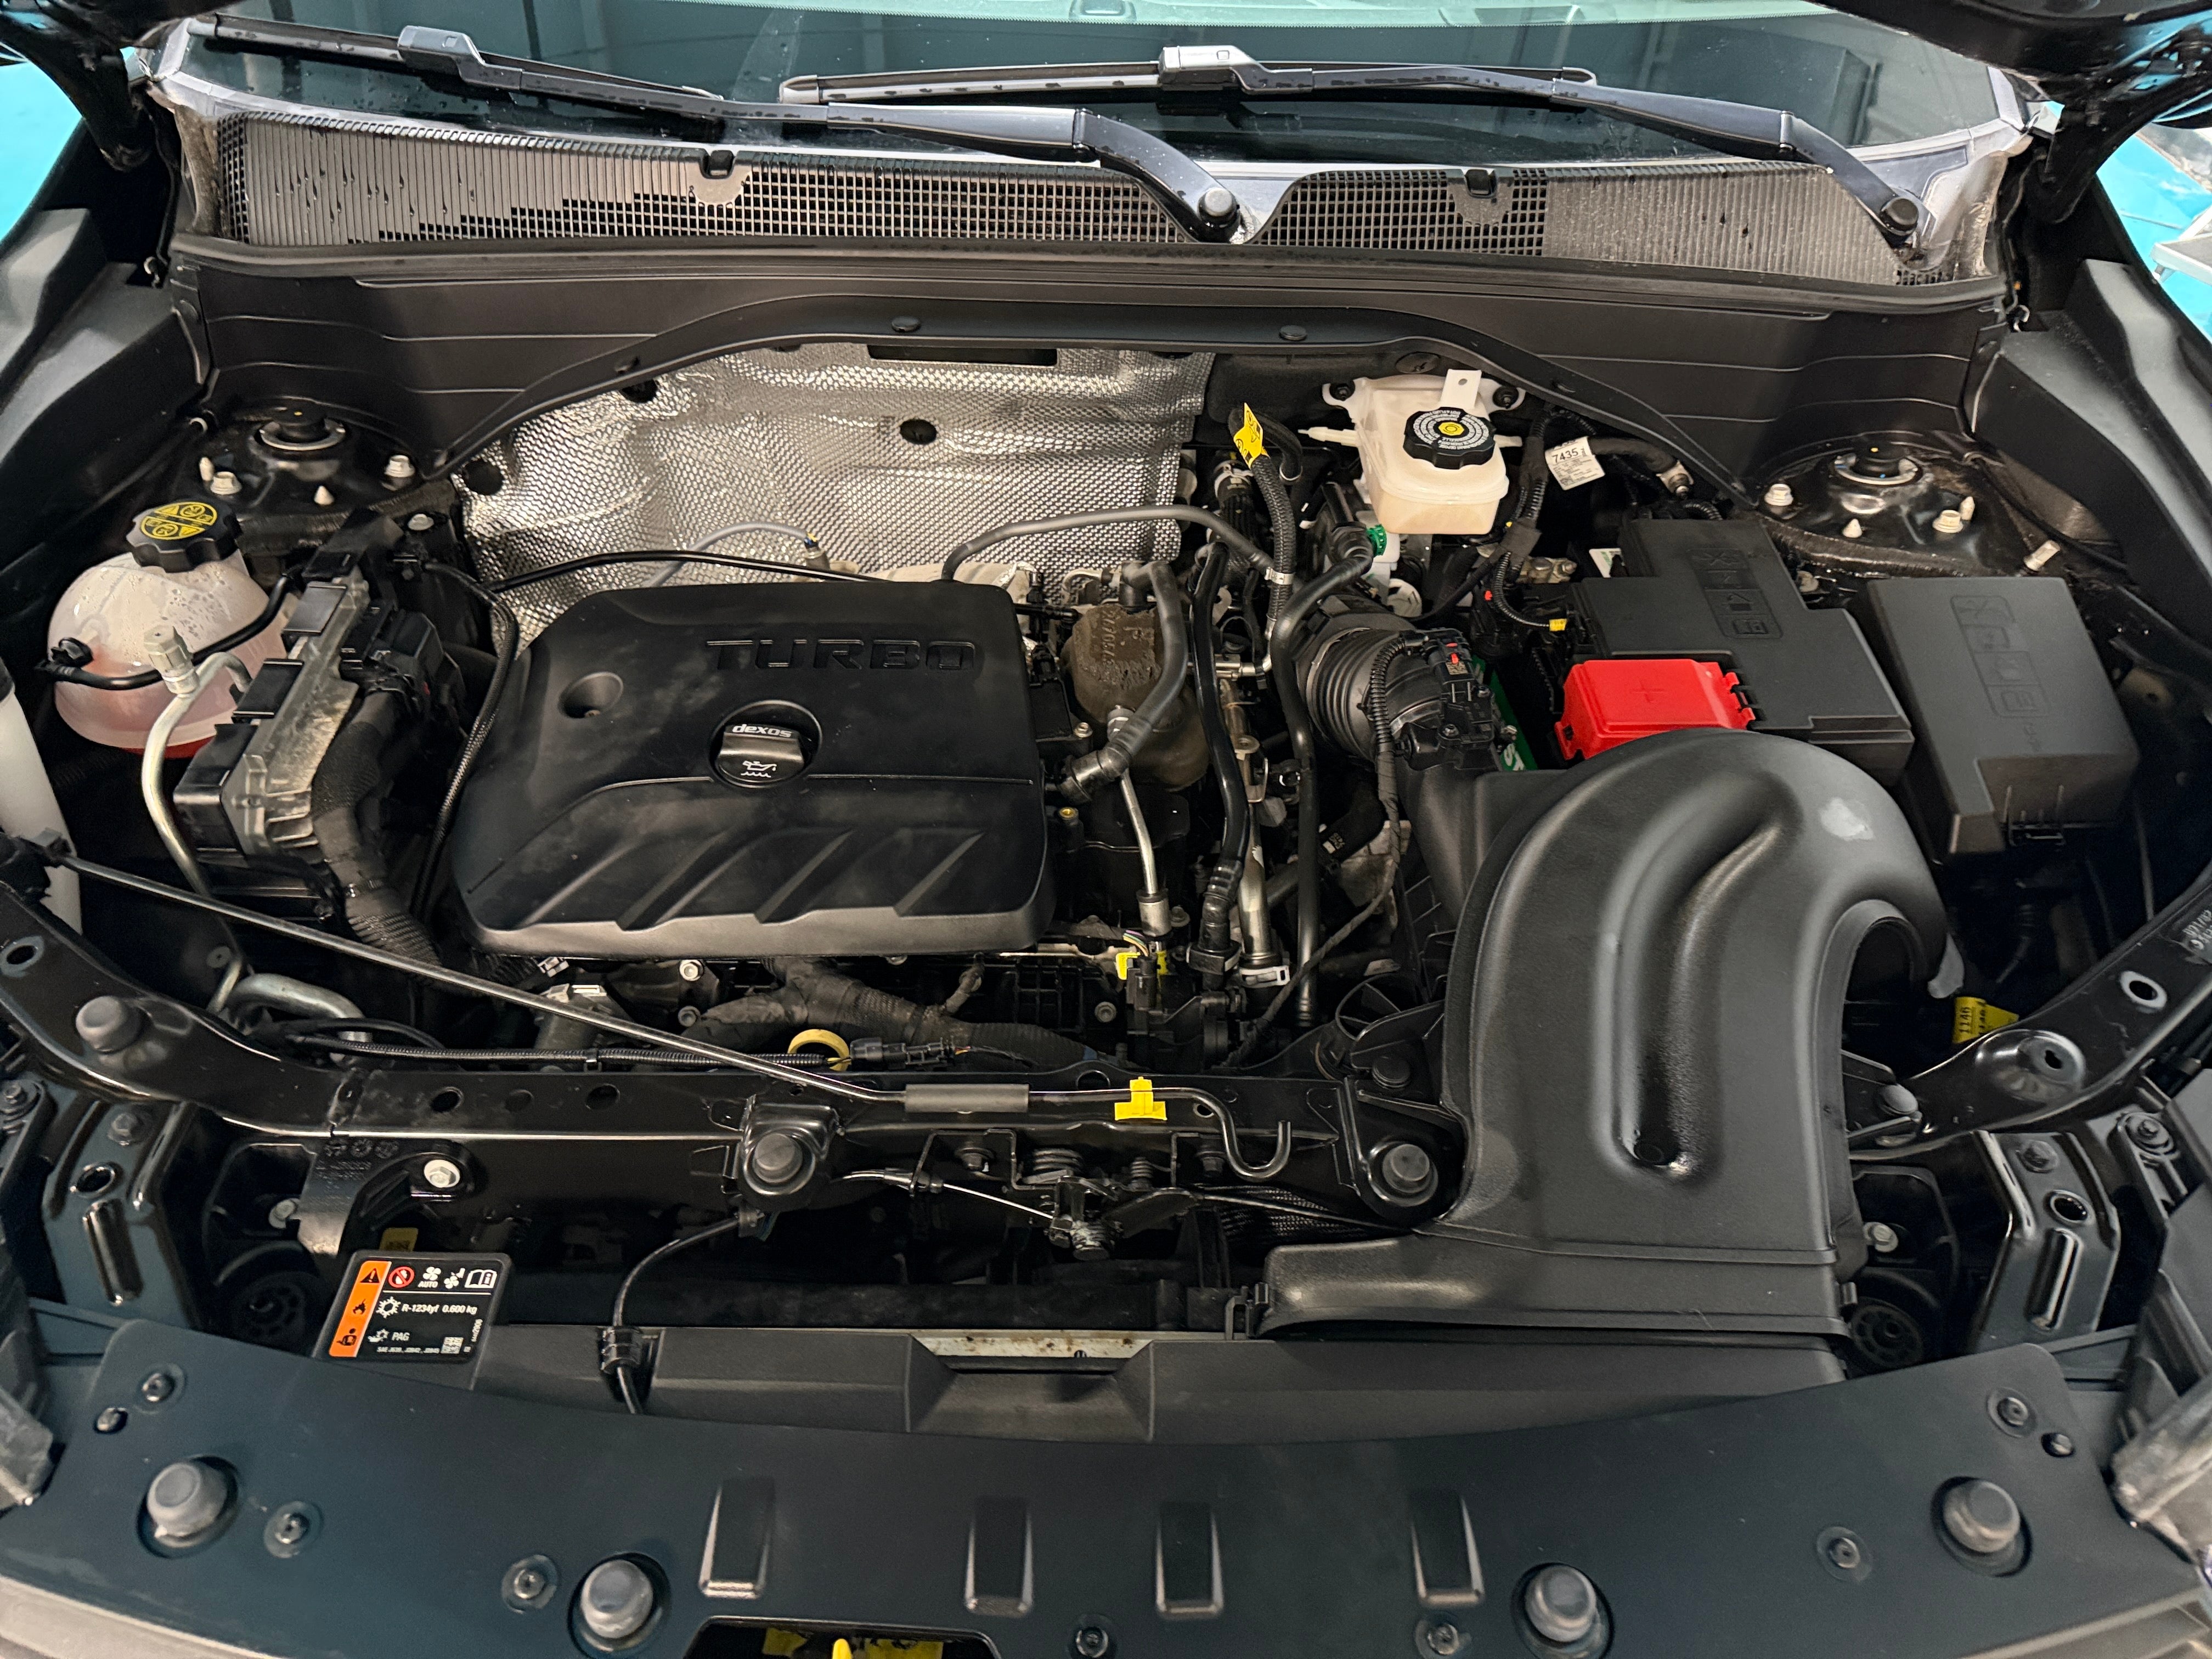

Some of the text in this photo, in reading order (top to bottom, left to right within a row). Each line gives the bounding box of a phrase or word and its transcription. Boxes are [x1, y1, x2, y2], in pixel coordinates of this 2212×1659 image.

[1551, 447, 1579, 463] 7435
[706, 639, 976, 670] TURBO
[732, 724, 792, 738] dexos
[401, 1304, 477, 1315] R-1234yf 0.600 kg
[392, 1332, 410, 1341] PAG
